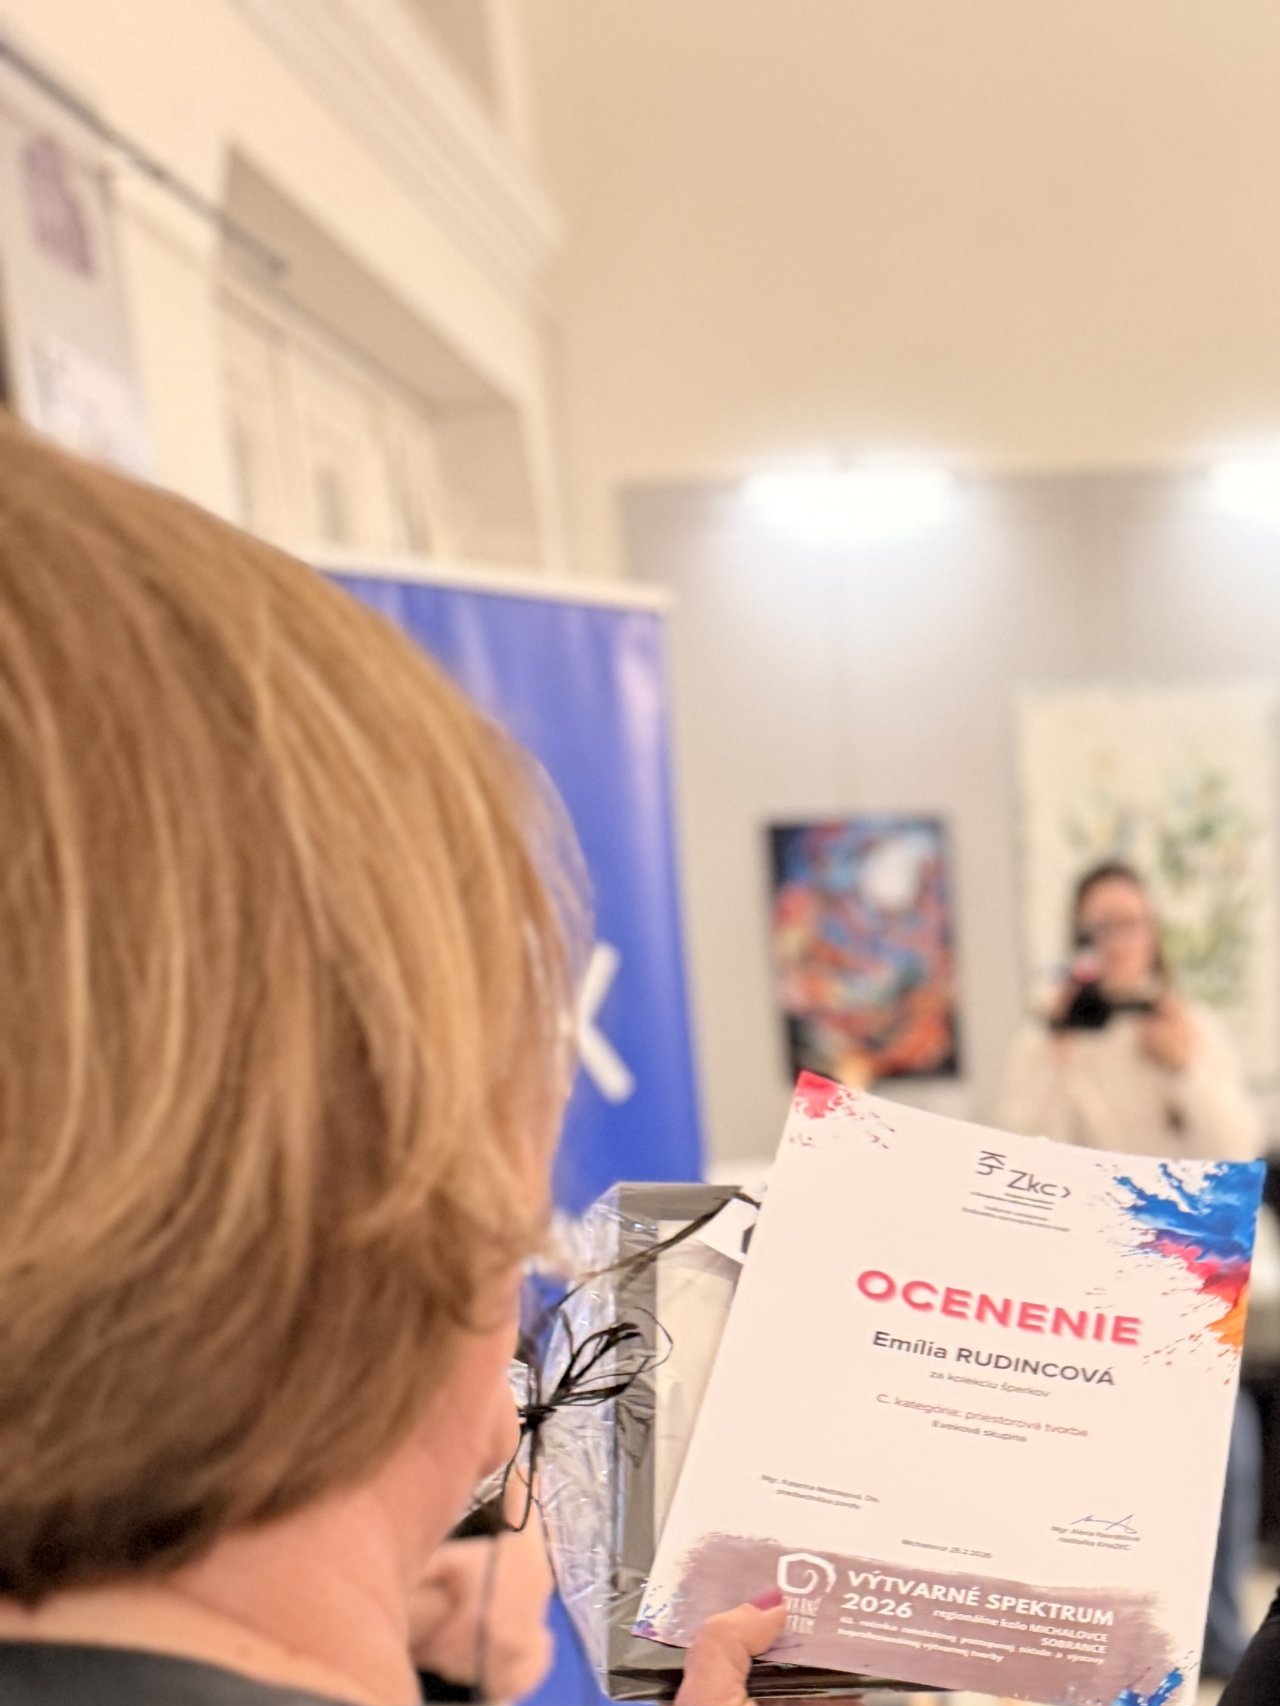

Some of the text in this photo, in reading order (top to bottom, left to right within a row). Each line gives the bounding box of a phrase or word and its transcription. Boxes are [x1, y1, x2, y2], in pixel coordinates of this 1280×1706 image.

[857, 1270, 1143, 1346] OCENENIE
[872, 1330, 1116, 1386] Emília RUDINCOVÁ
[840, 1593, 913, 1618] 2026
[848, 1570, 981, 1606] VÝTVARNÉ
[984, 1594, 1115, 1626] SPEKTRUM
[999, 1618, 1028, 1631] kolo
[1029, 1623, 1109, 1642] MICHALOVCE
[1040, 1637, 1108, 1653] SOBRANCE
